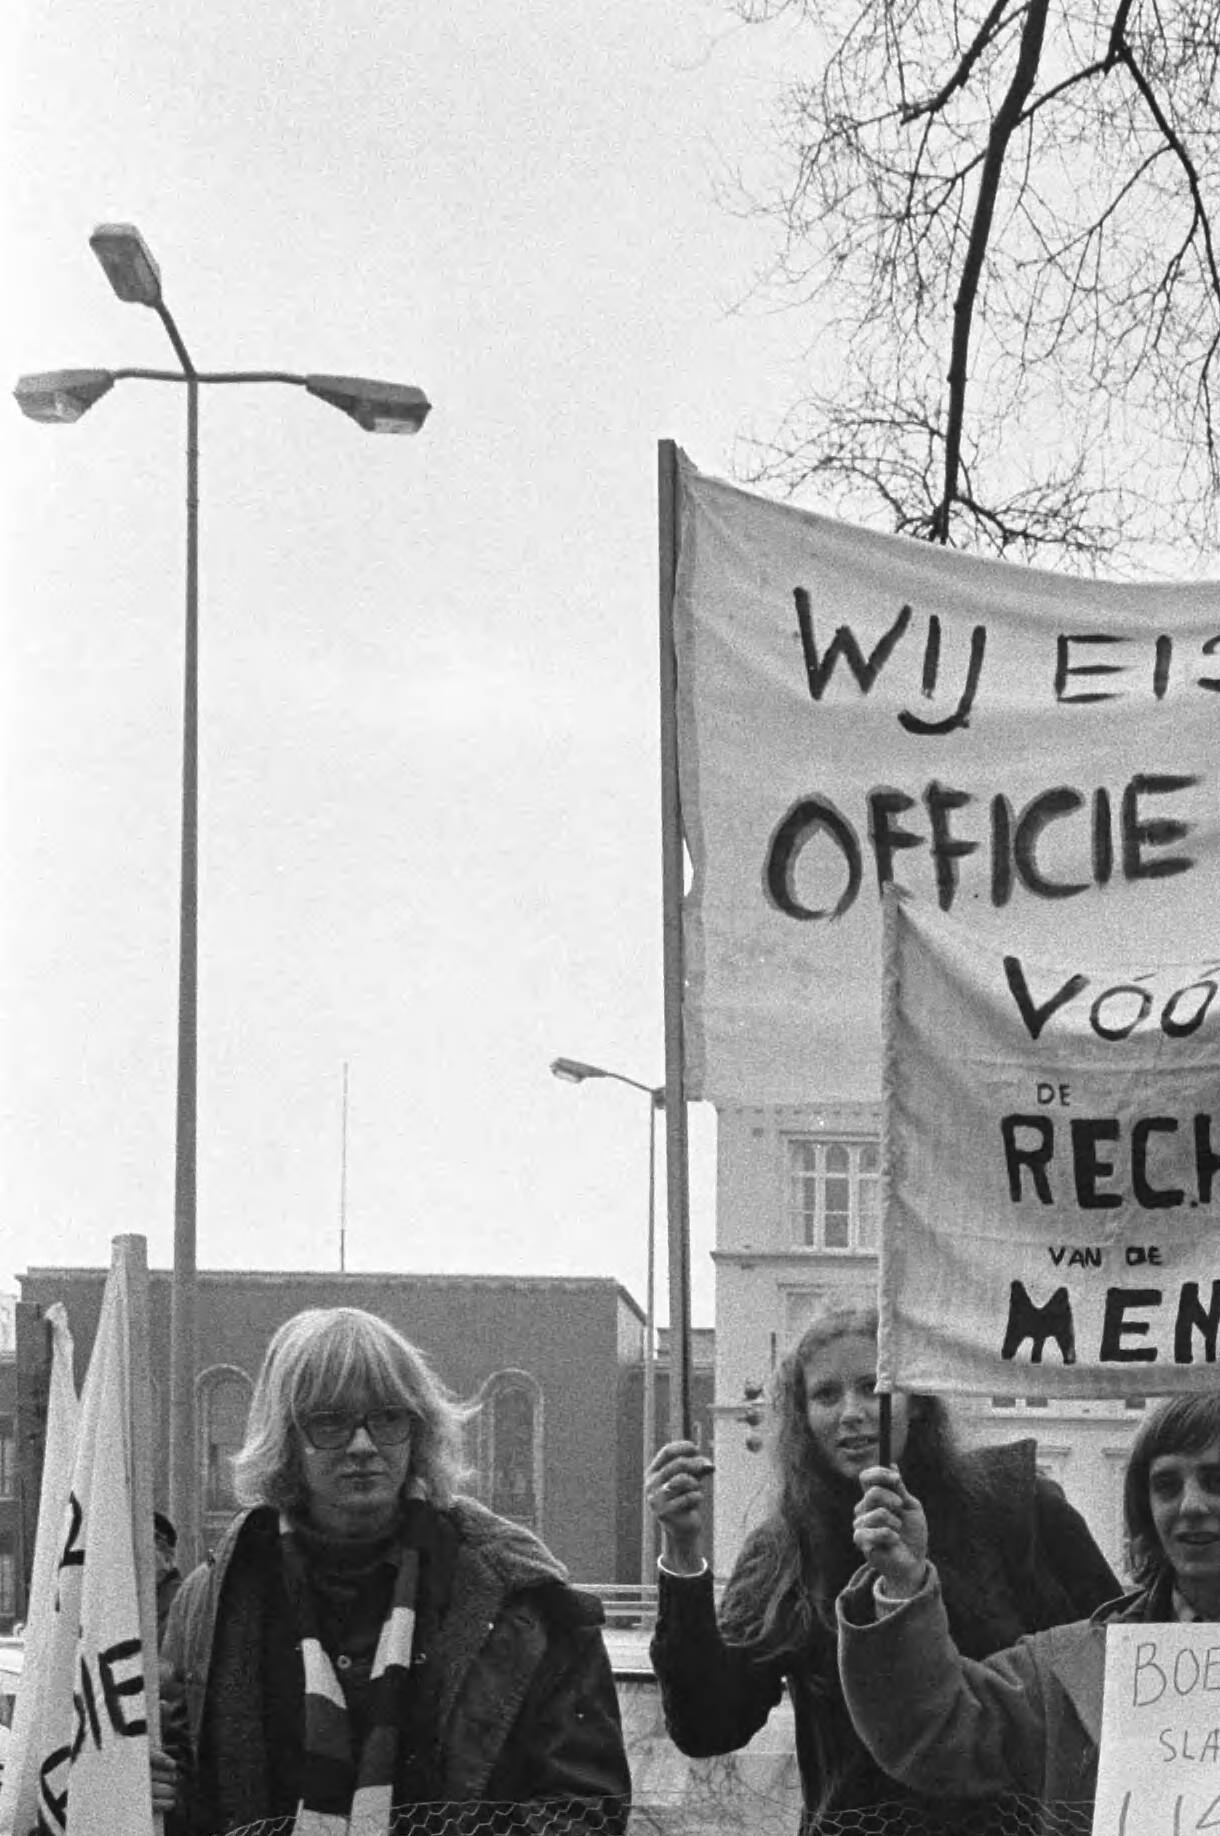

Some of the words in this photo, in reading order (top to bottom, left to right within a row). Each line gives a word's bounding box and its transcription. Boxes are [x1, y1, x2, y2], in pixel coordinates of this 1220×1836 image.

[792, 586, 987, 735] WIJ
[1036, 1083, 1072, 1107] DE
[1048, 1246, 1102, 1268] VAN
[1125, 1245, 1163, 1268] DE
